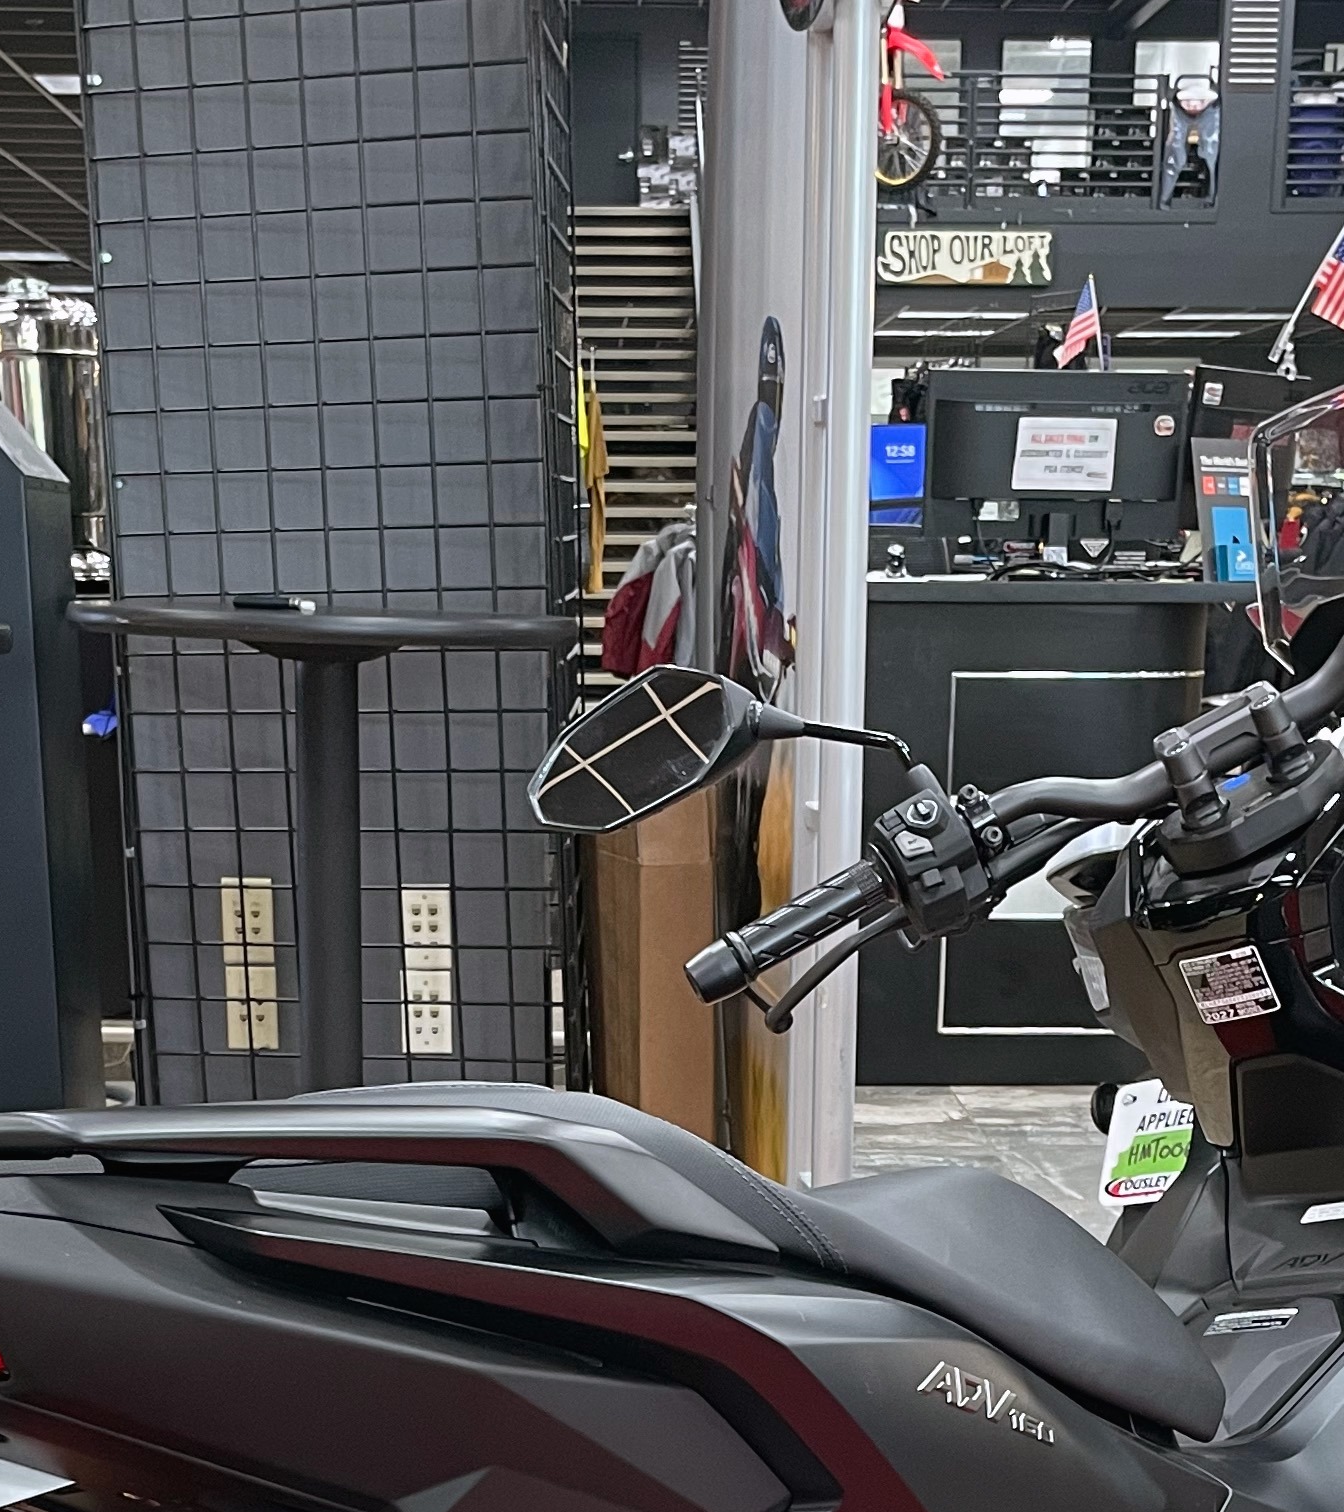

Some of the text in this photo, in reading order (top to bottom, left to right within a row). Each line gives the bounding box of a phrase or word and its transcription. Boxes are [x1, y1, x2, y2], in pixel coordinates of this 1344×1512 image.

[881, 234, 1047, 277] SHOP OUR LOFT
[1136, 1108, 1194, 1133] APPLIED
